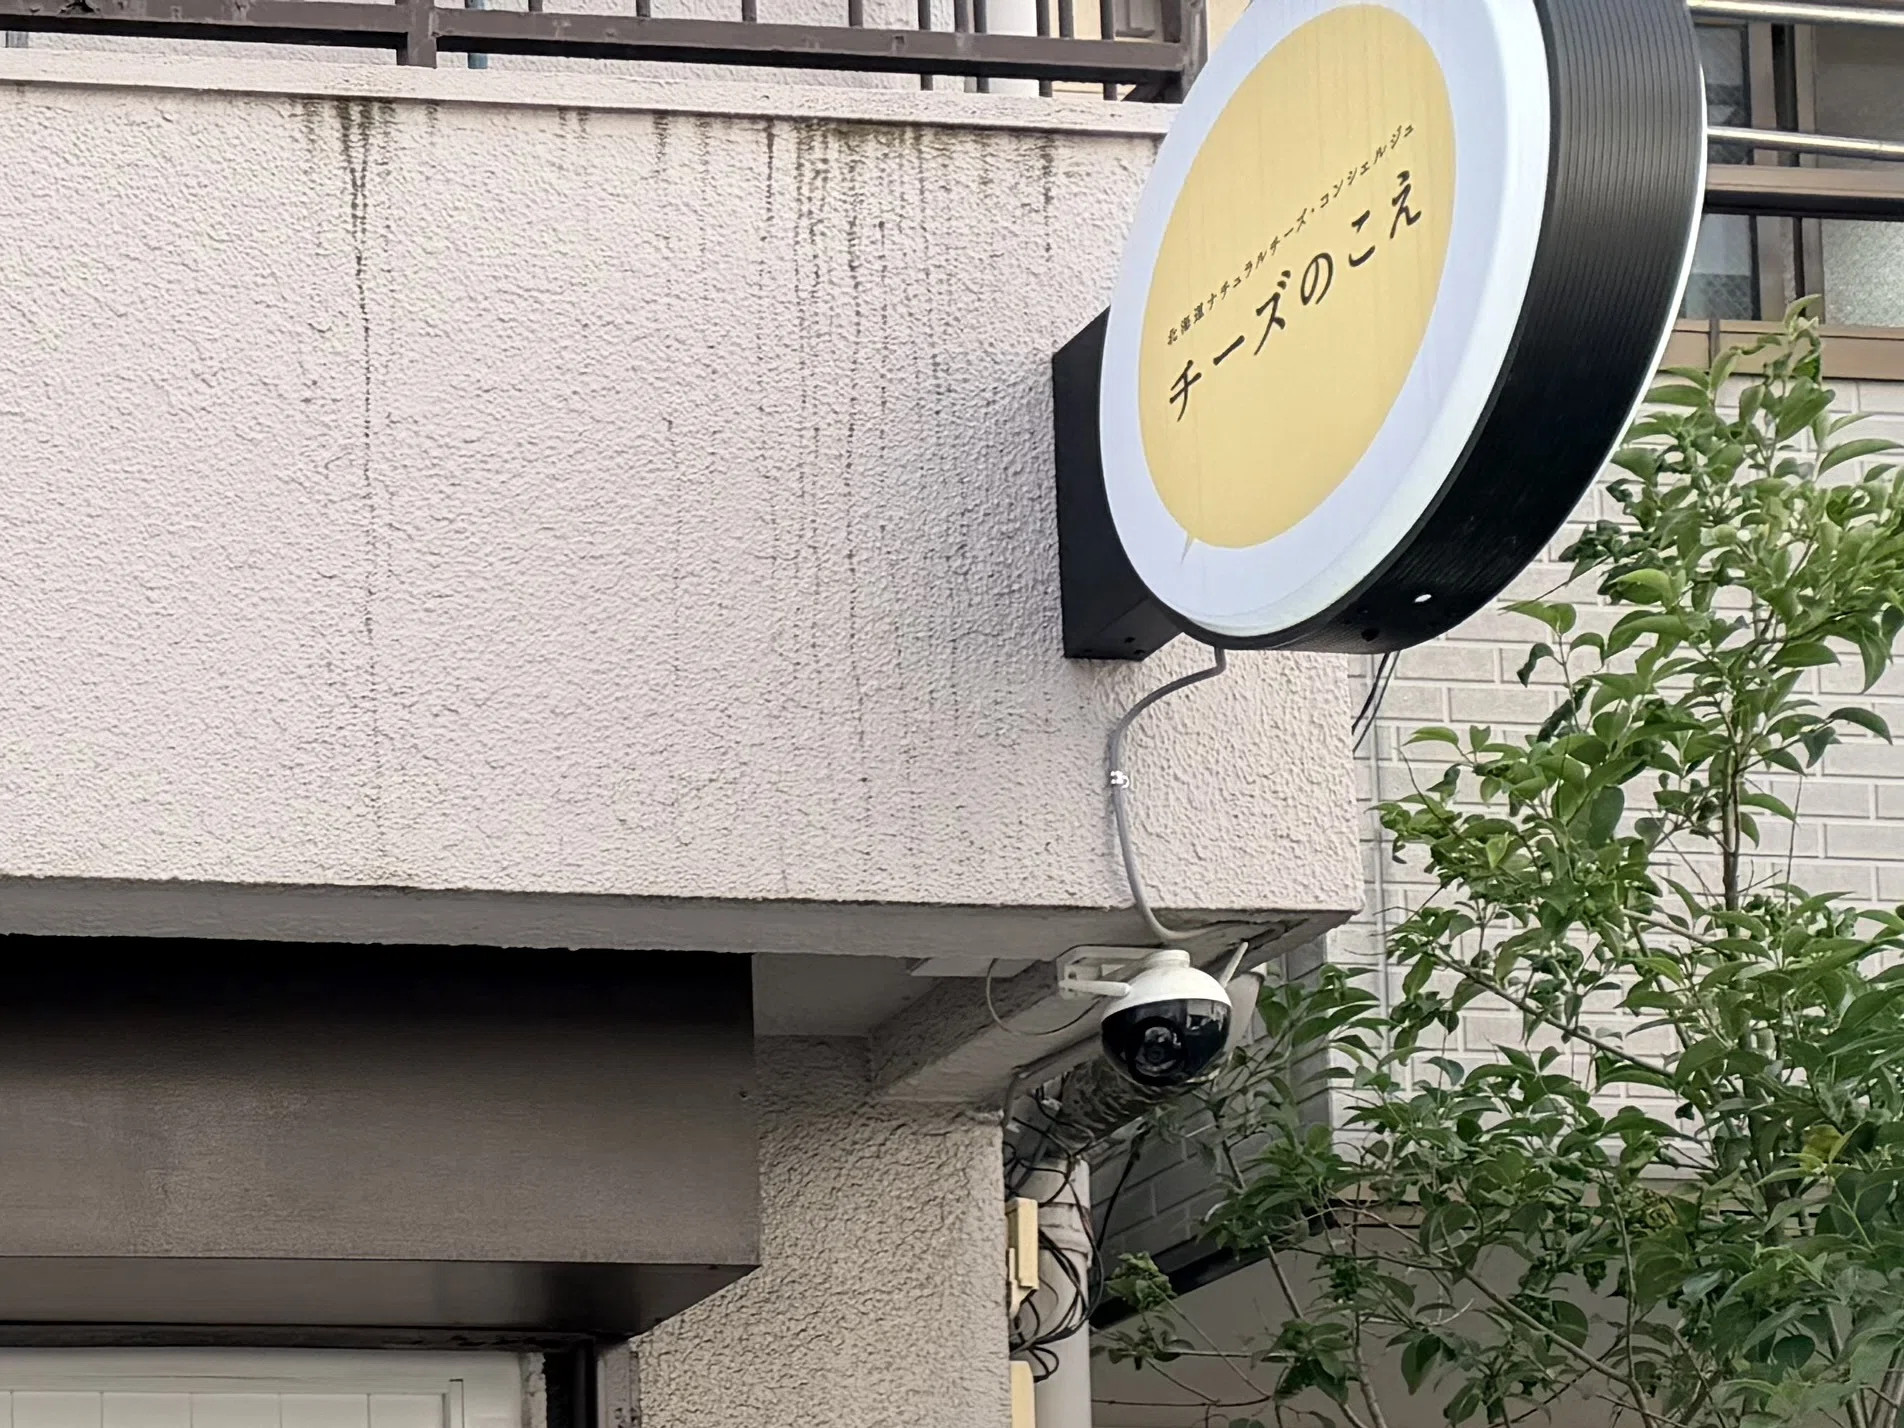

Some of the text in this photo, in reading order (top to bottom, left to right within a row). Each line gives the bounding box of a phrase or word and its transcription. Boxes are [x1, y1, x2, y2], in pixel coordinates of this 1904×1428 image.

[1168, 170, 1422, 422] チーズのこえ
